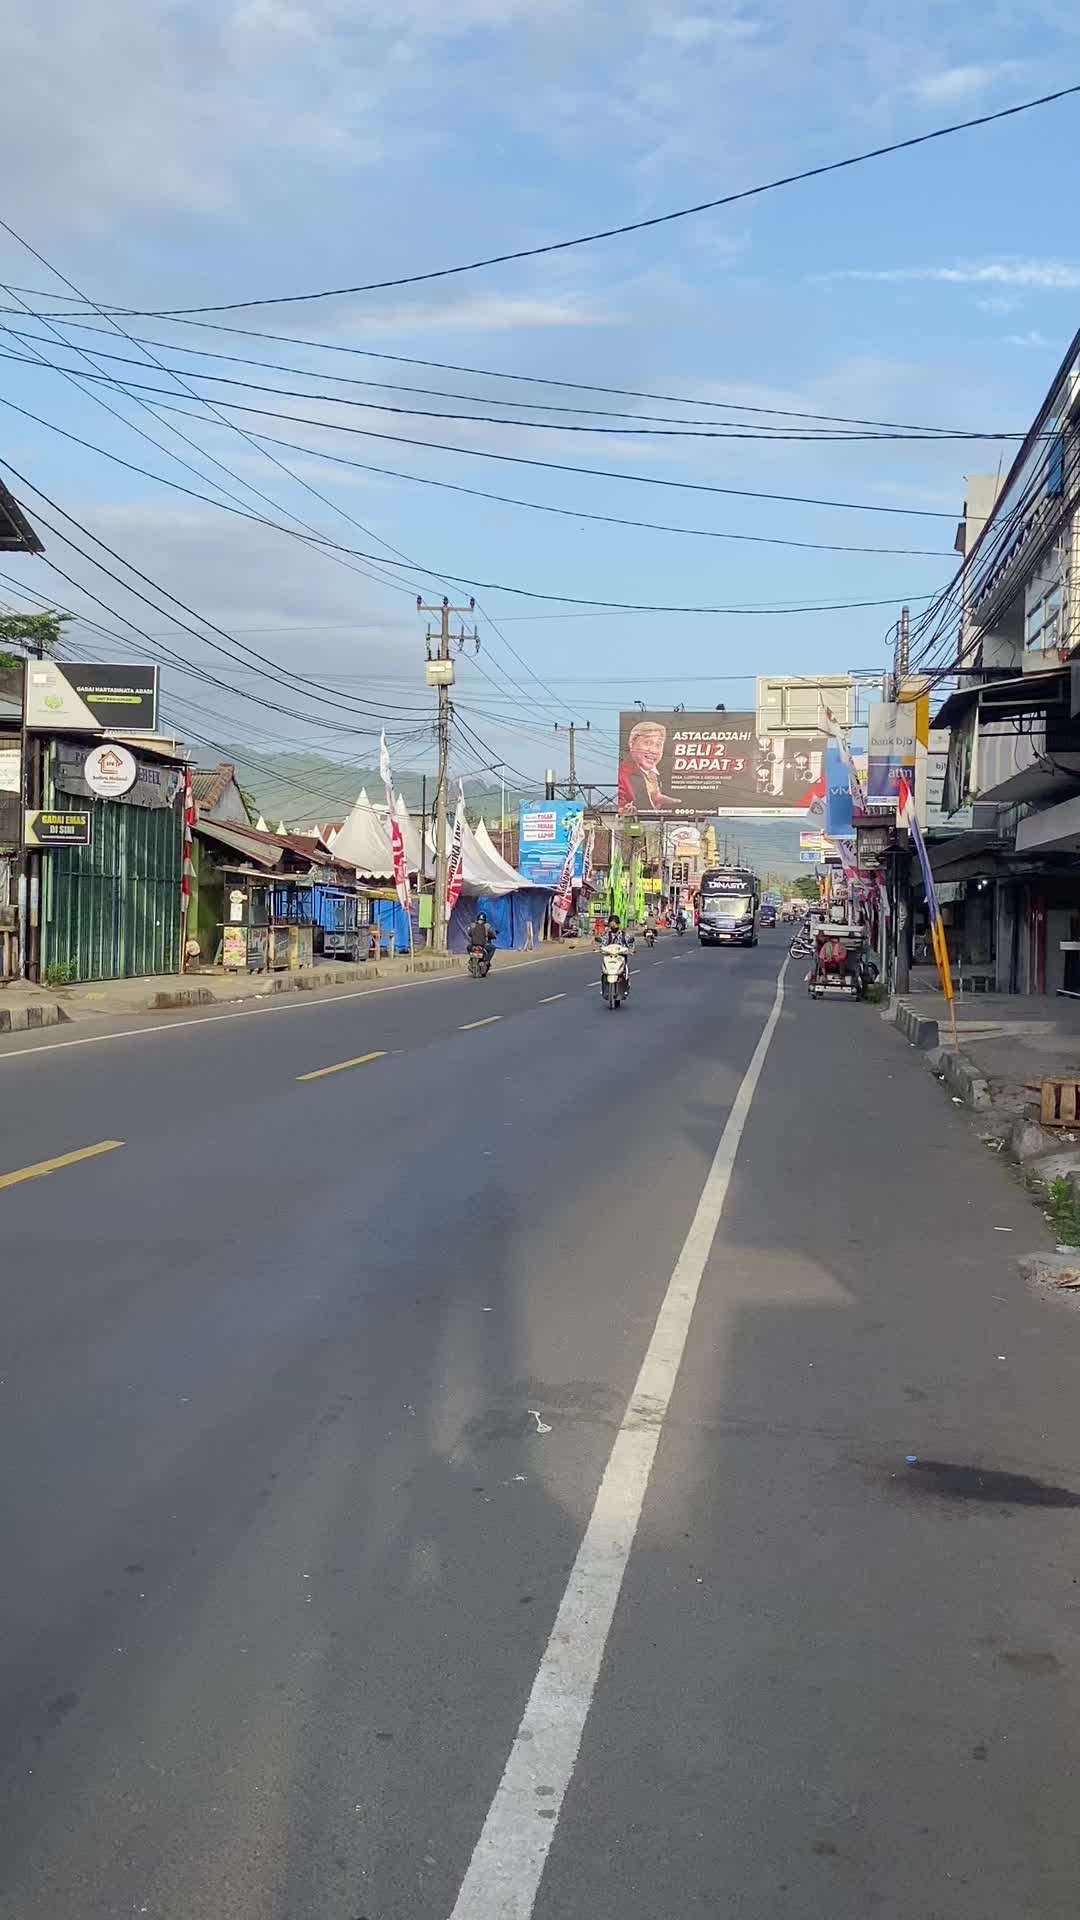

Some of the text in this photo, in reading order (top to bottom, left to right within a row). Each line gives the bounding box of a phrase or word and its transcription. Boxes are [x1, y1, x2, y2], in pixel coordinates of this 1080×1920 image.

[673, 732, 752, 741] ASTAGADJAH!
[871, 737, 913, 747] bank bjb
[674, 743, 726, 756] BELI 2
[674, 758, 745, 771] DAPAT 3
[888, 769, 913, 778] atm
[830, 786, 849, 795] viv
[42, 815, 86, 825] GADAI EMAS
[50, 825, 75, 834] DI SINI
[707, 881, 748, 889] DINASTY
